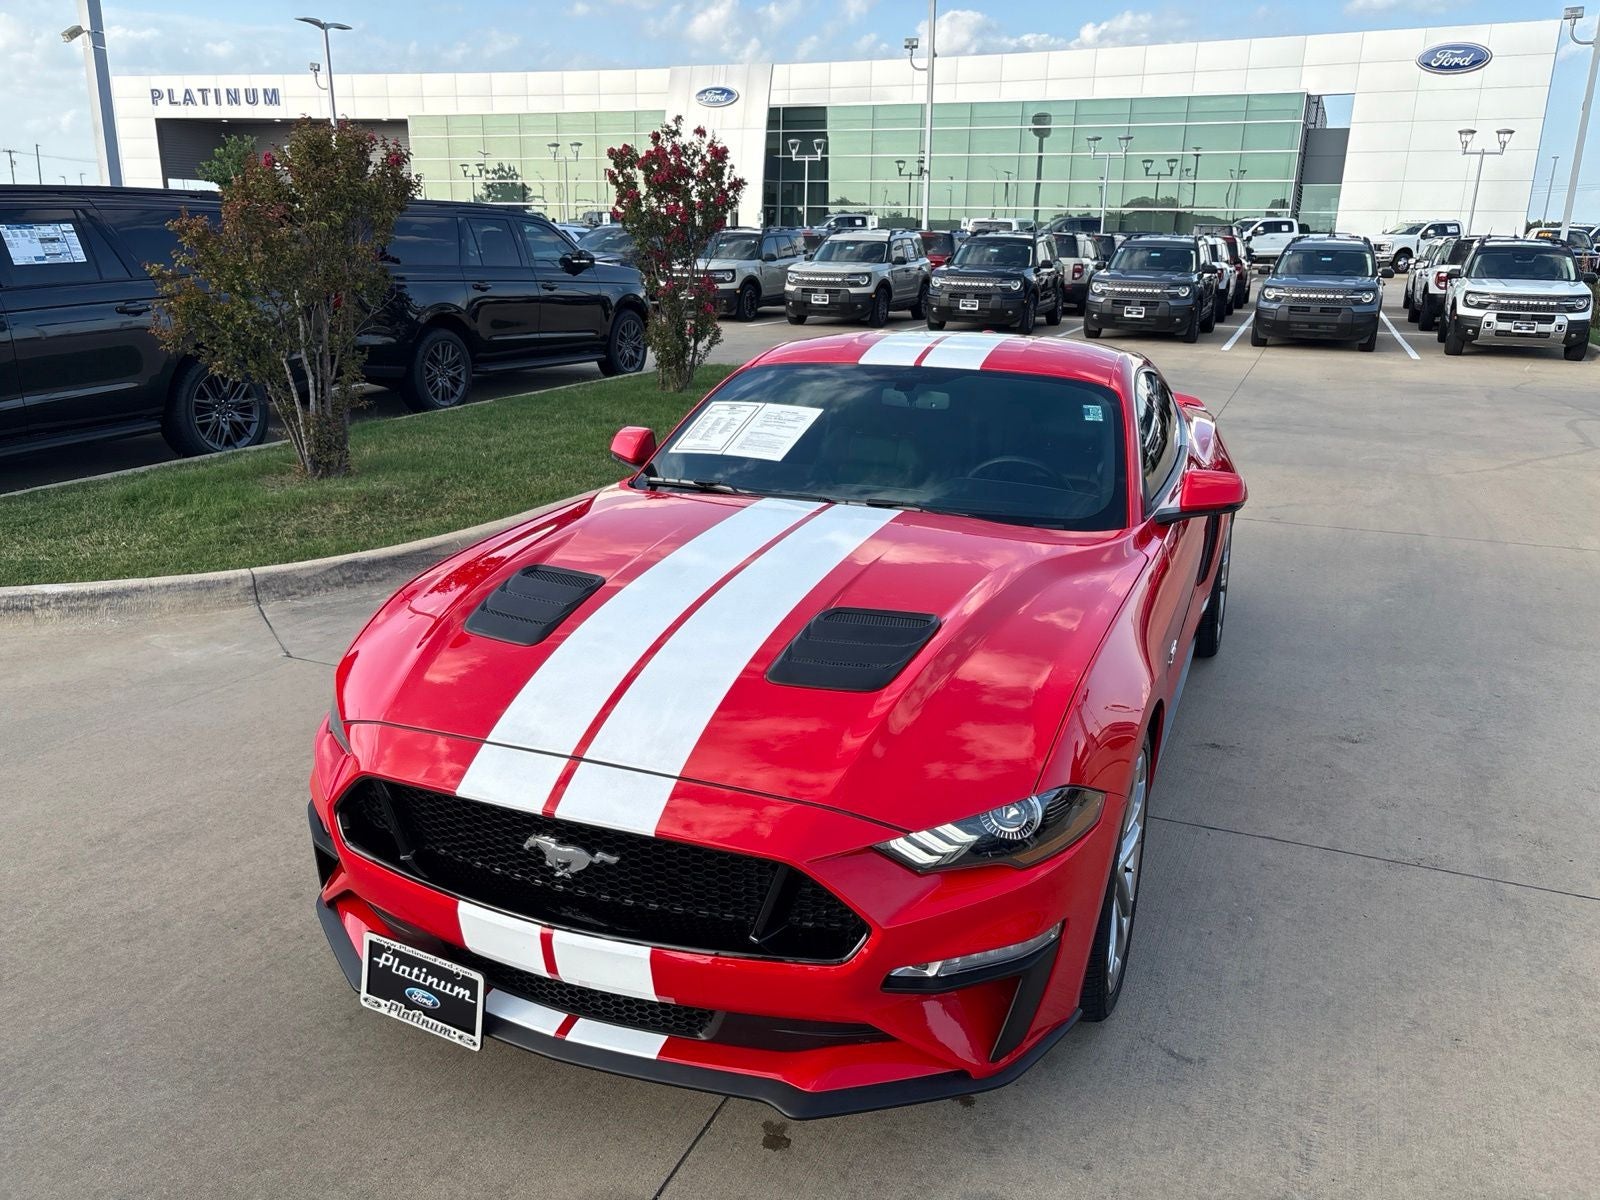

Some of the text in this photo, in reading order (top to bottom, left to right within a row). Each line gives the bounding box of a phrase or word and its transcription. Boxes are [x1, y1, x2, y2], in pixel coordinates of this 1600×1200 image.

[1430, 49, 1474, 67] Ford
[150, 88, 280, 106] PLATINUM
[702, 89, 728, 102] Ford
[372, 953, 477, 1004] Platinum
[410, 989, 435, 1007] Ford
[388, 1000, 456, 1039] Platinum
